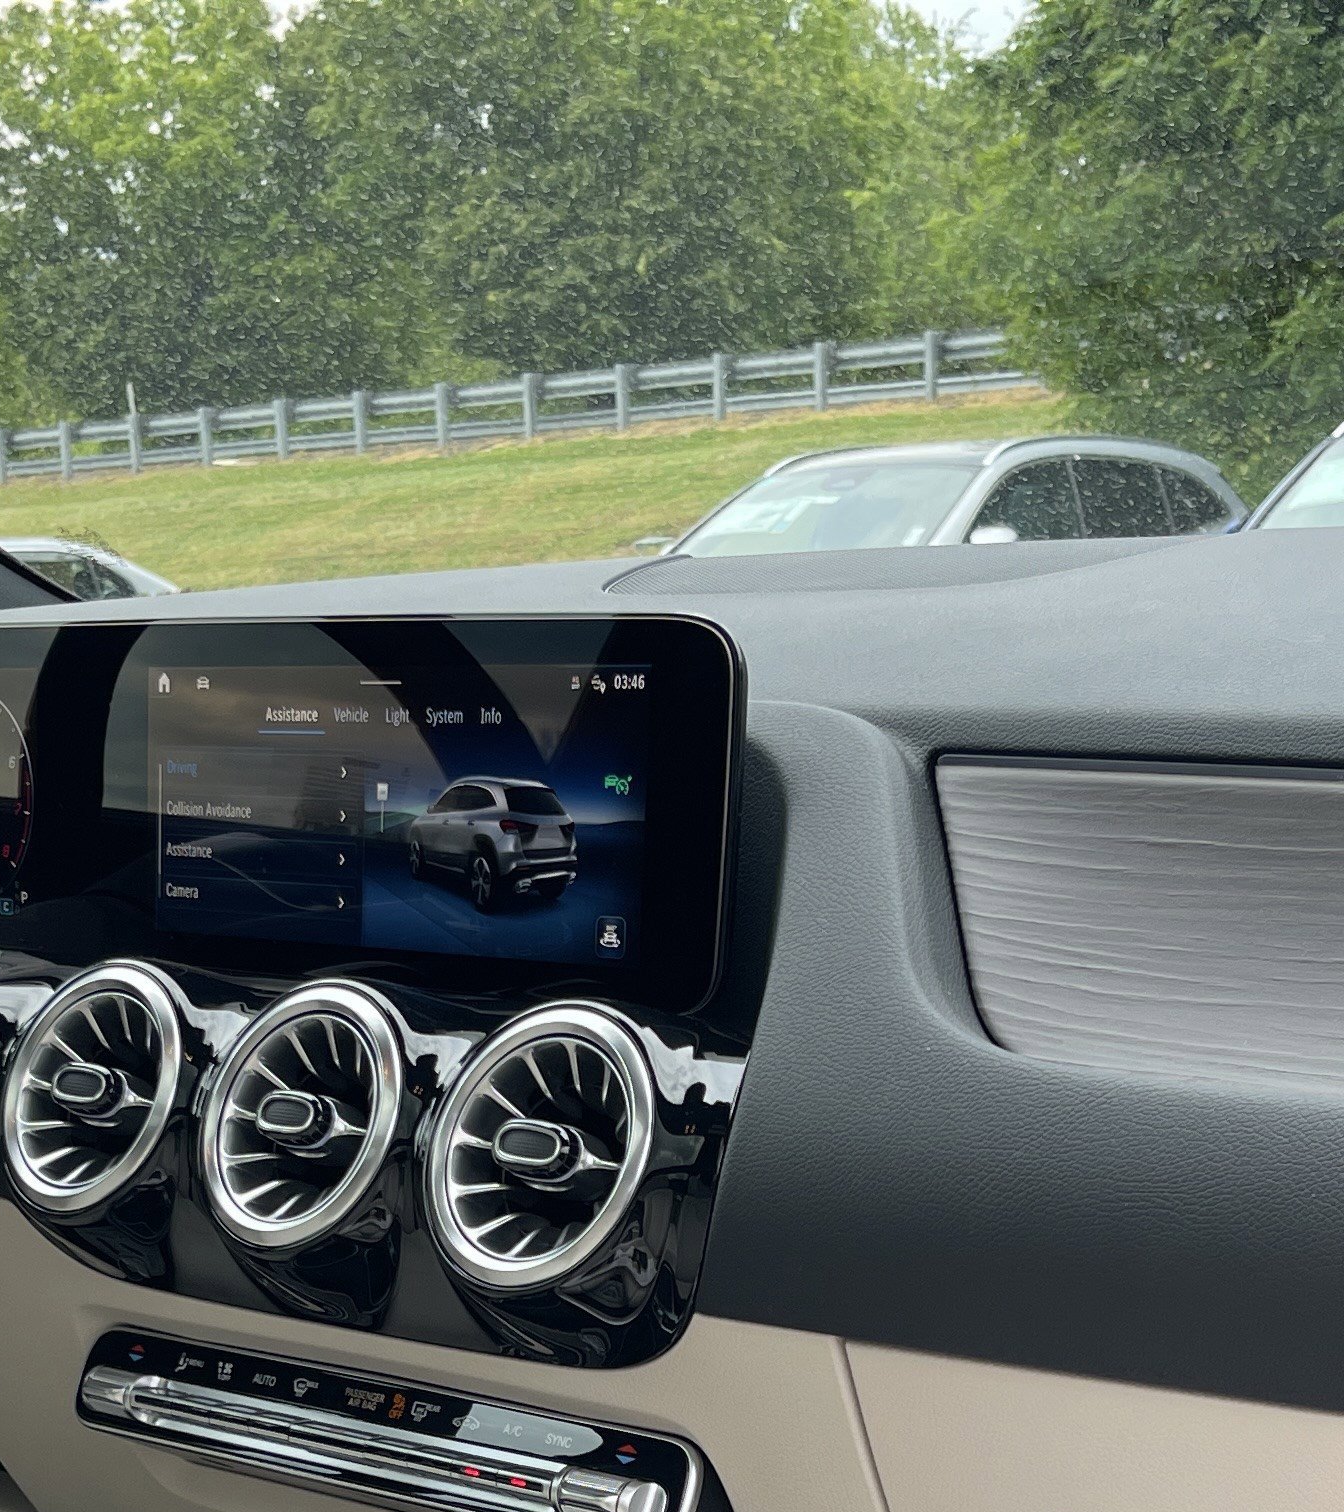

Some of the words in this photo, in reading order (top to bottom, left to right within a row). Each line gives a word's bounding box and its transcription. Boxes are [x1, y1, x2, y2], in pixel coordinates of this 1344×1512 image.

[613, 674, 645, 691] 03:46
[265, 707, 319, 723] Assistance
[333, 707, 369, 724] Vehicle
[385, 708, 410, 726] Light
[426, 708, 463, 726] System
[481, 708, 502, 725] Info
[9, 756, 15, 769] 6
[167, 759, 197, 776] Driving
[166, 801, 203, 818] Collision
[206, 803, 251, 820] Avoidance
[166, 843, 212, 860] Assistance
[166, 883, 199, 899] Camera
[252, 1373, 276, 1387] AUTO
[503, 1424, 523, 1437] A/C
[545, 1433, 573, 1448] SYNC
